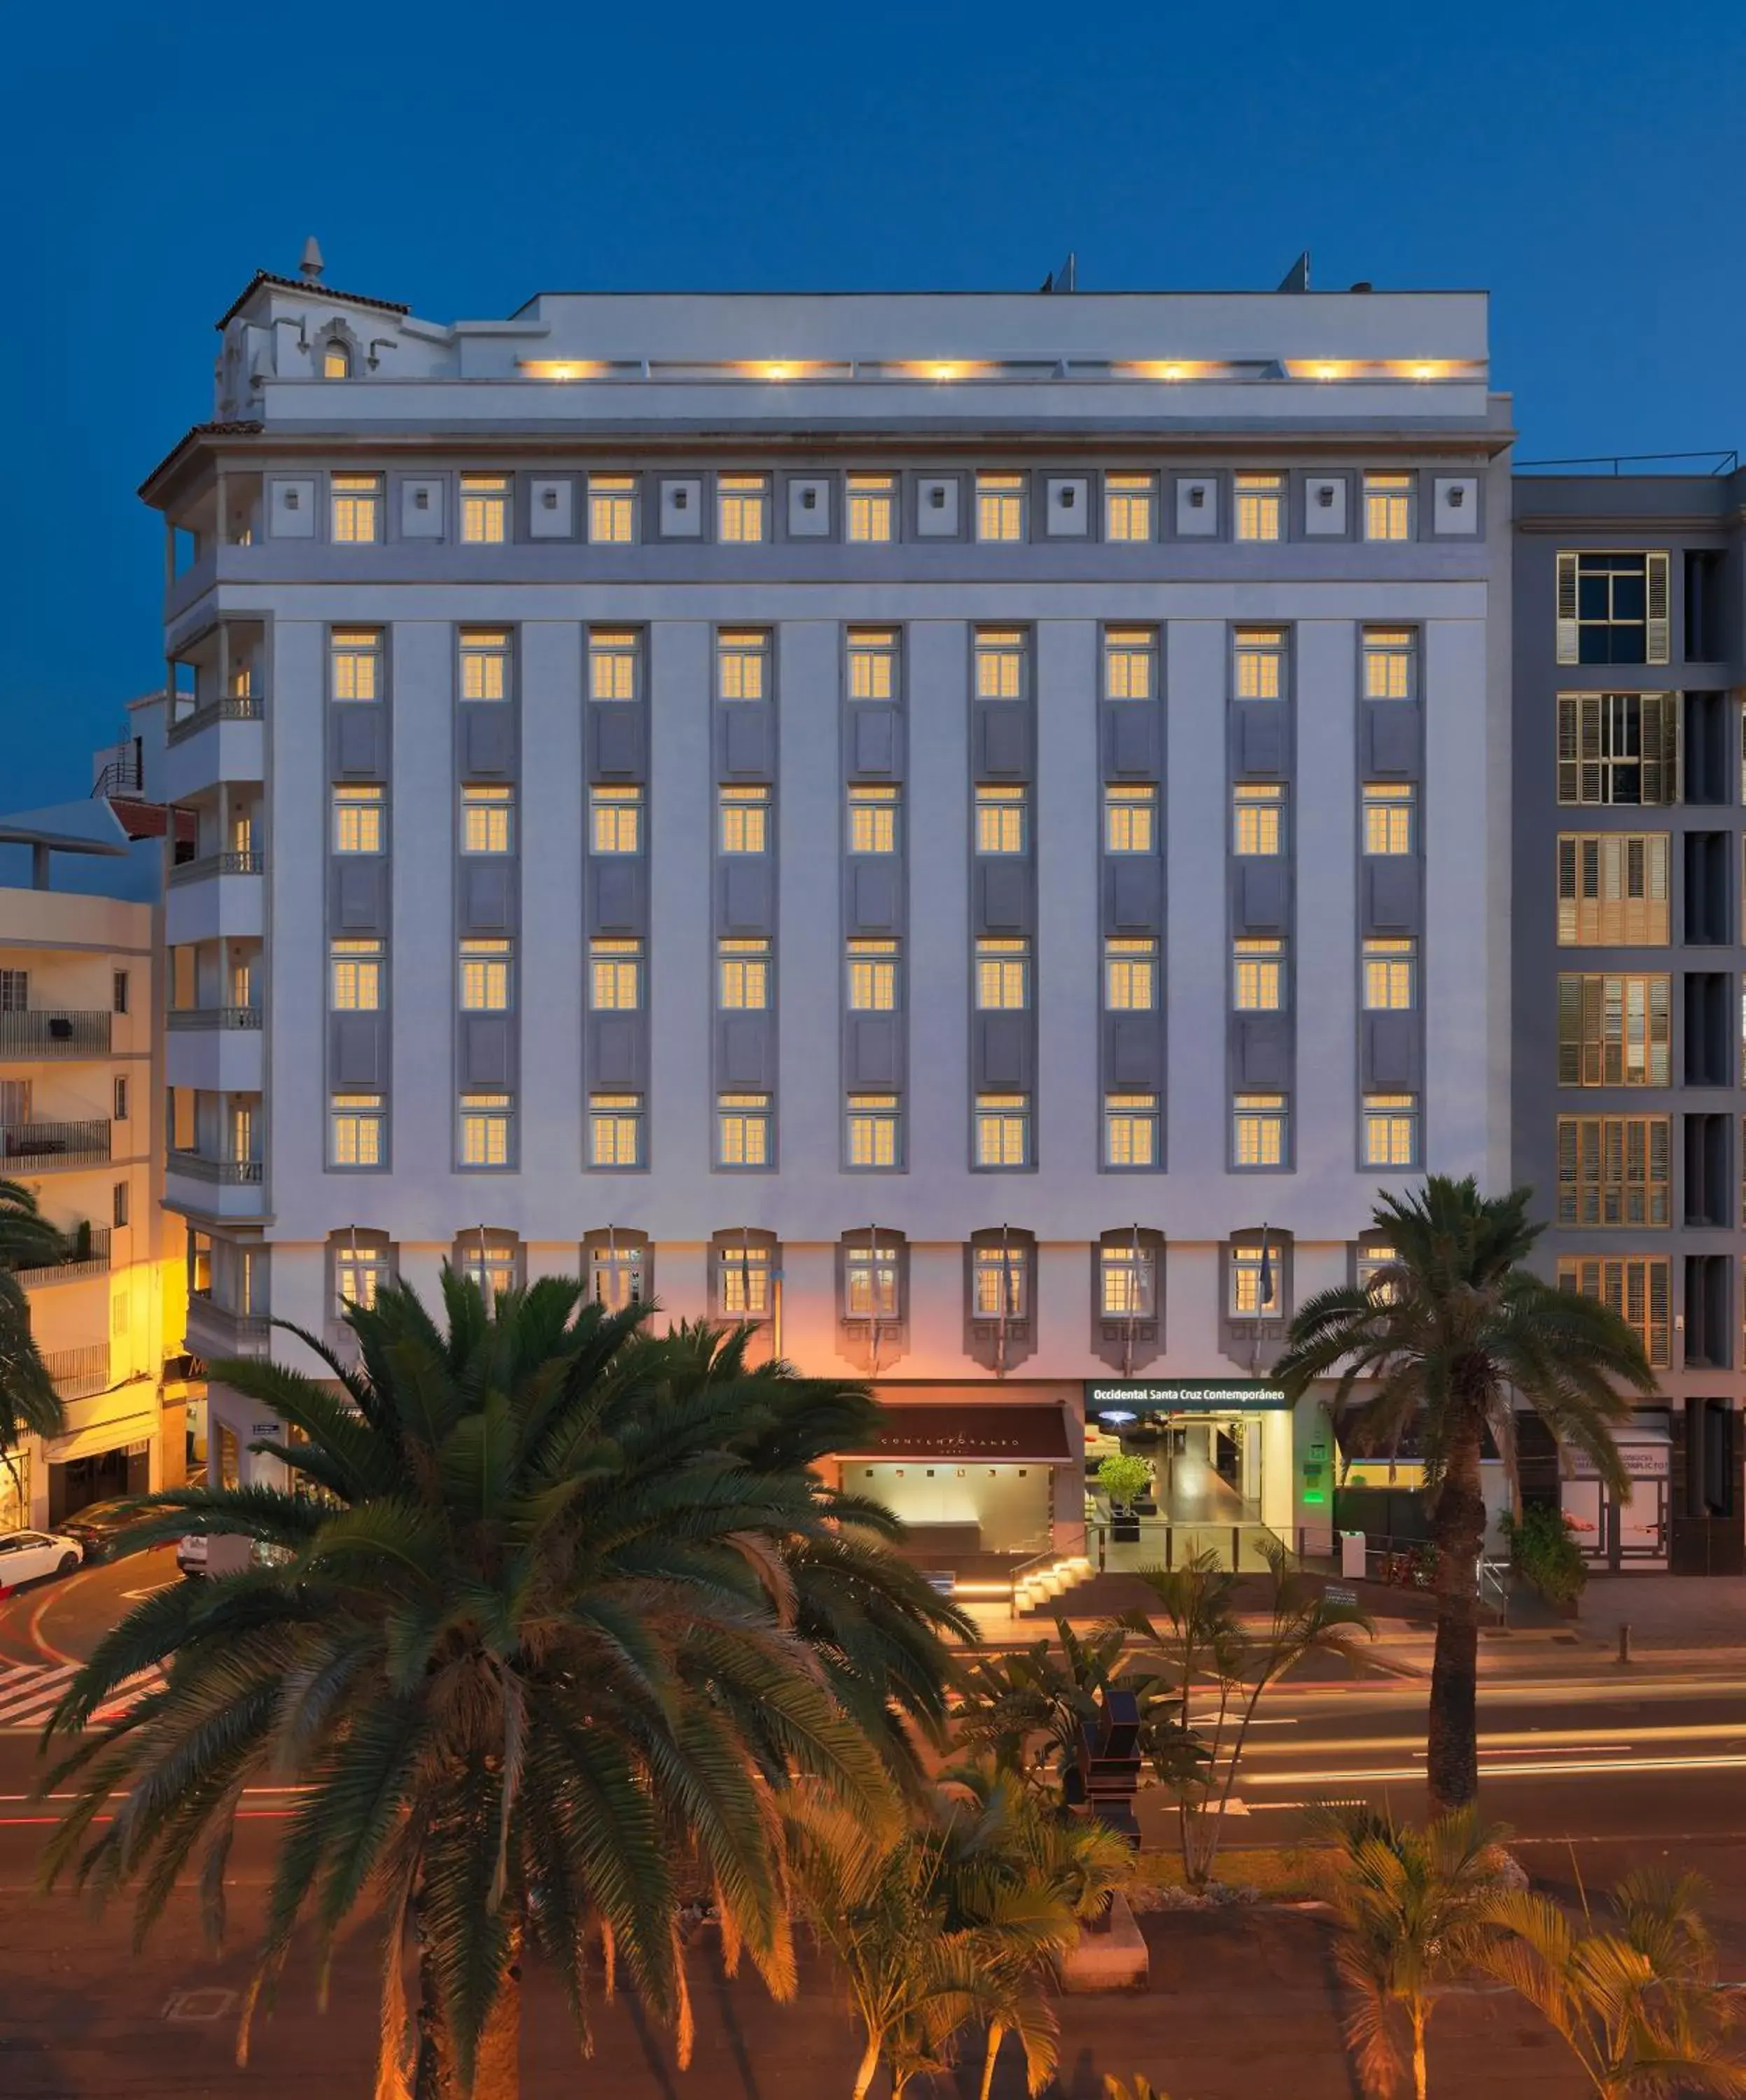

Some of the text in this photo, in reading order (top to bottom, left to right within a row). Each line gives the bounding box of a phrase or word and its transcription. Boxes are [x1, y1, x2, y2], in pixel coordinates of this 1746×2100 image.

[1094, 1389, 1285, 1402] Occidental Santa Cruz Contemporáneo
